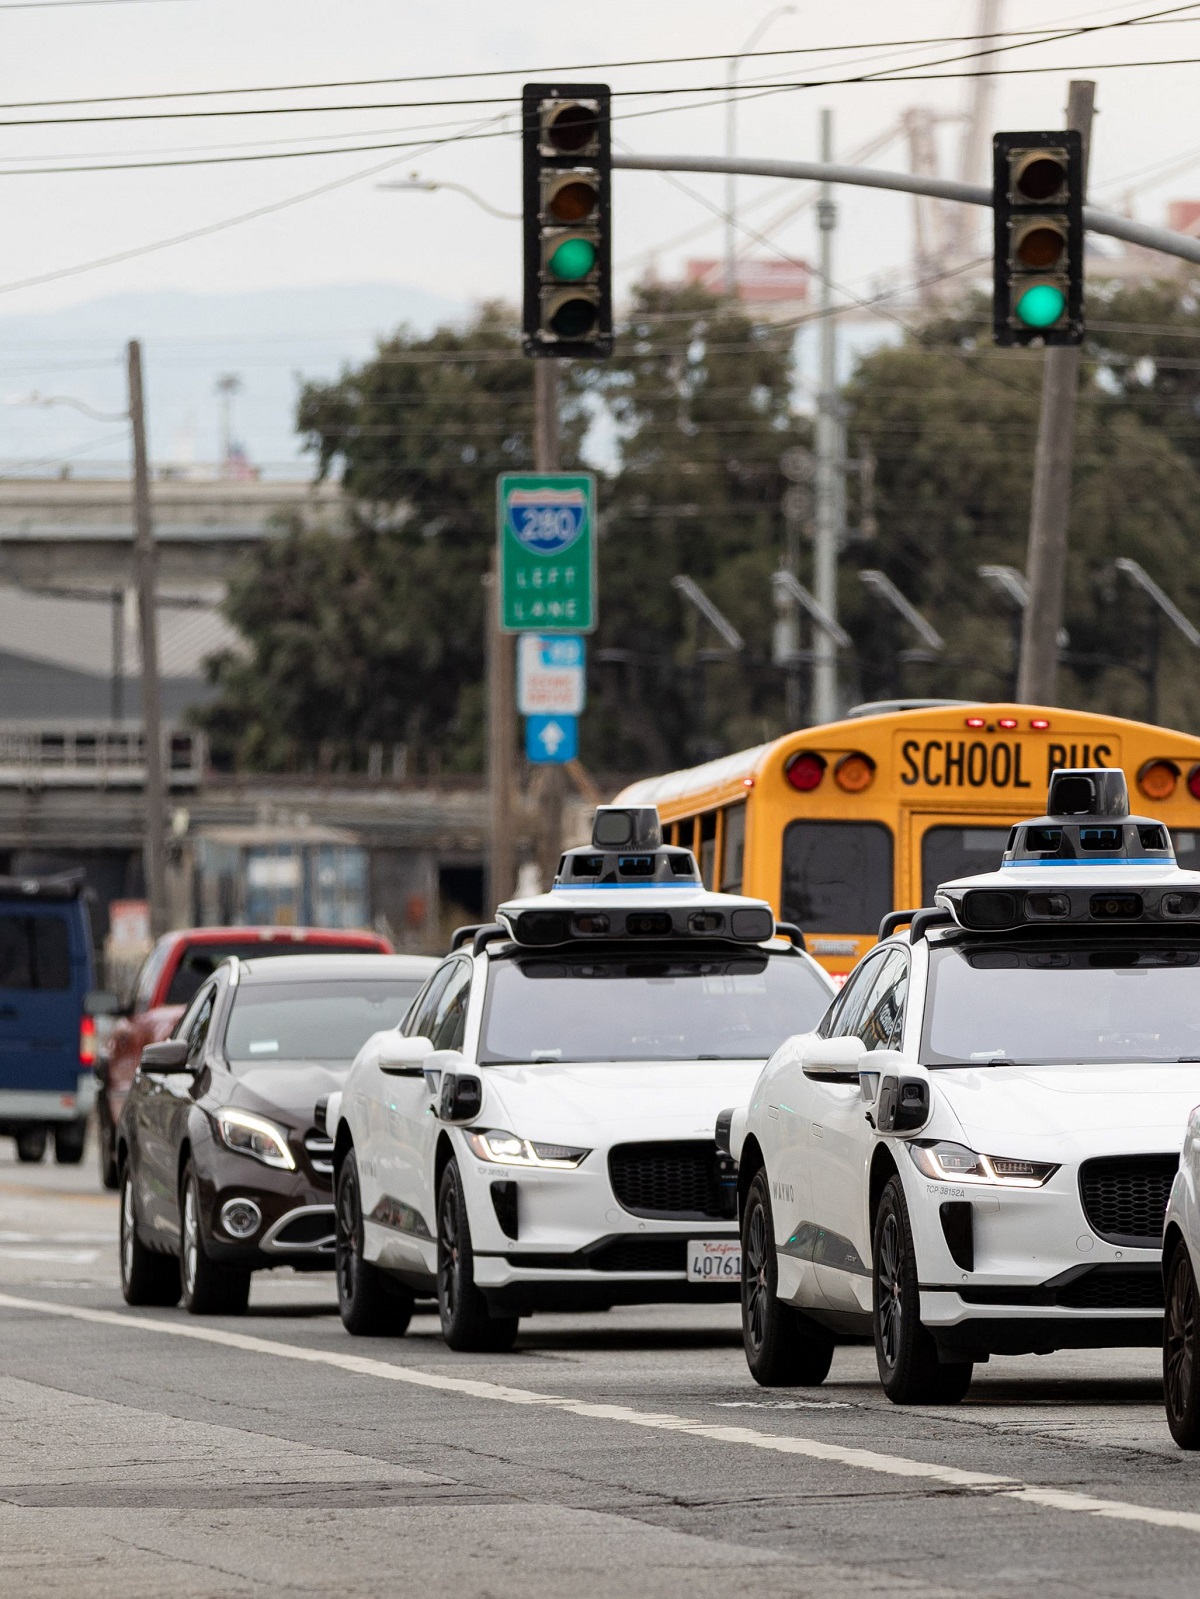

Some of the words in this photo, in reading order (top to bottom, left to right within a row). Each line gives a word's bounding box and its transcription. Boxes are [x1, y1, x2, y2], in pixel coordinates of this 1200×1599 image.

[520, 508, 577, 542] 280
[516, 567, 575, 589] LEFT
[514, 599, 577, 620] LANE
[900, 739, 1031, 788] SCHOOL
[1047, 743, 1112, 784] BUS
[773, 1181, 794, 1203] WAYMO
[926, 1184, 939, 1194] TCP
[940, 1186, 965, 1198] 38152A
